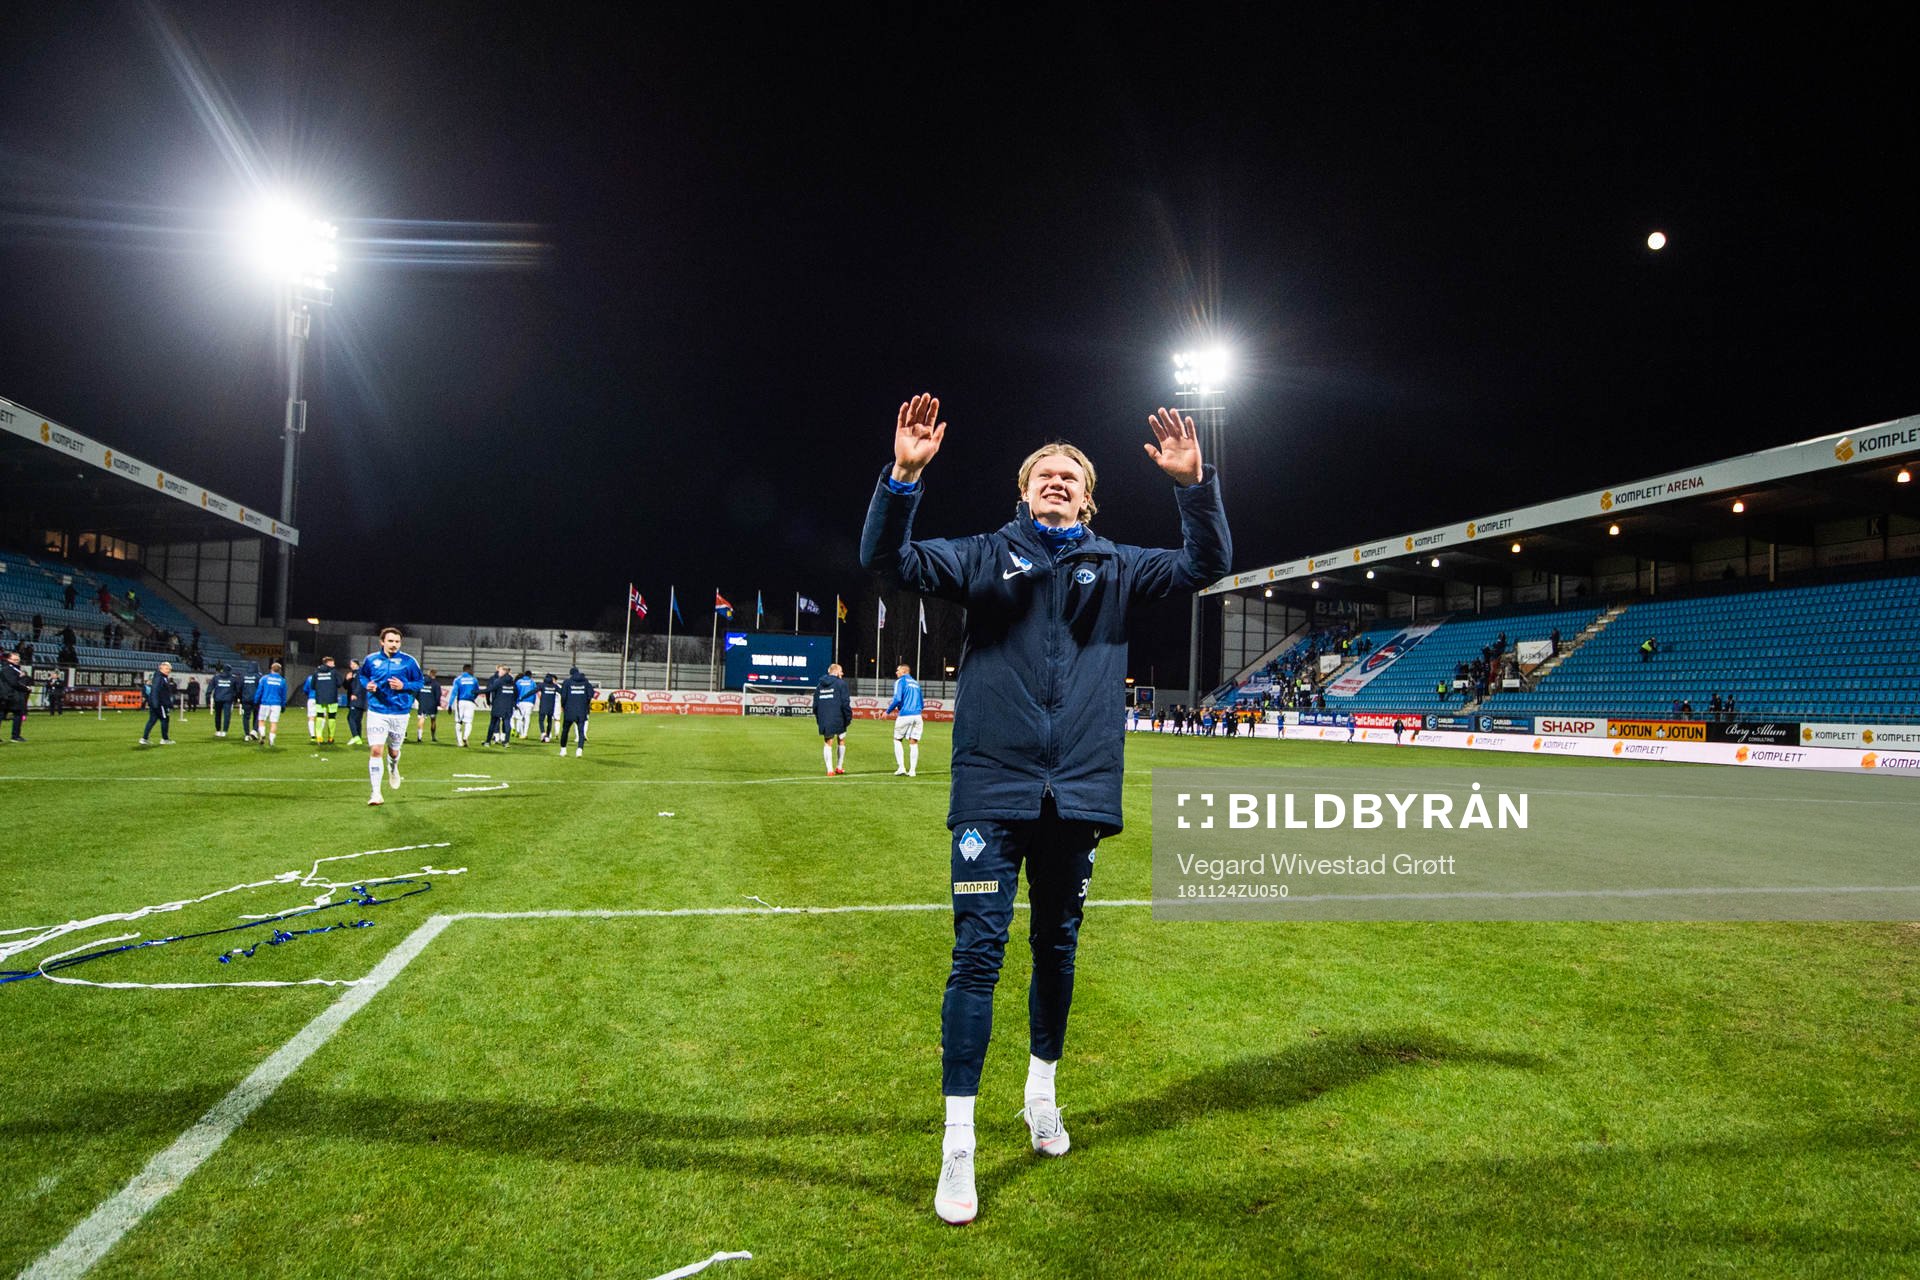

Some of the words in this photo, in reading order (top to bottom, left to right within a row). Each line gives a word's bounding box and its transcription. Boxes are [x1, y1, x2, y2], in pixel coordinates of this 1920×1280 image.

[1859, 427, 1920, 453] KOMPLE
[1615, 484, 1665, 504] KOMPLETT
[1667, 476, 1704, 494] ARENA
[1477, 517, 1513, 534] KOMPLETT
[1415, 533, 1445, 547] KOMPLETT
[1542, 720, 1595, 734] SHARP
[1619, 725, 1652, 737] JOTUN
[1666, 726, 1704, 739] JOTUN
[1815, 731, 1856, 741] KOMPLETT
[1625, 745, 1667, 755] KOMPLETT
[1751, 751, 1806, 763] KOMPLETT
[1881, 757, 1920, 769] KOMPL
[1078, 878, 1092, 898] 3
